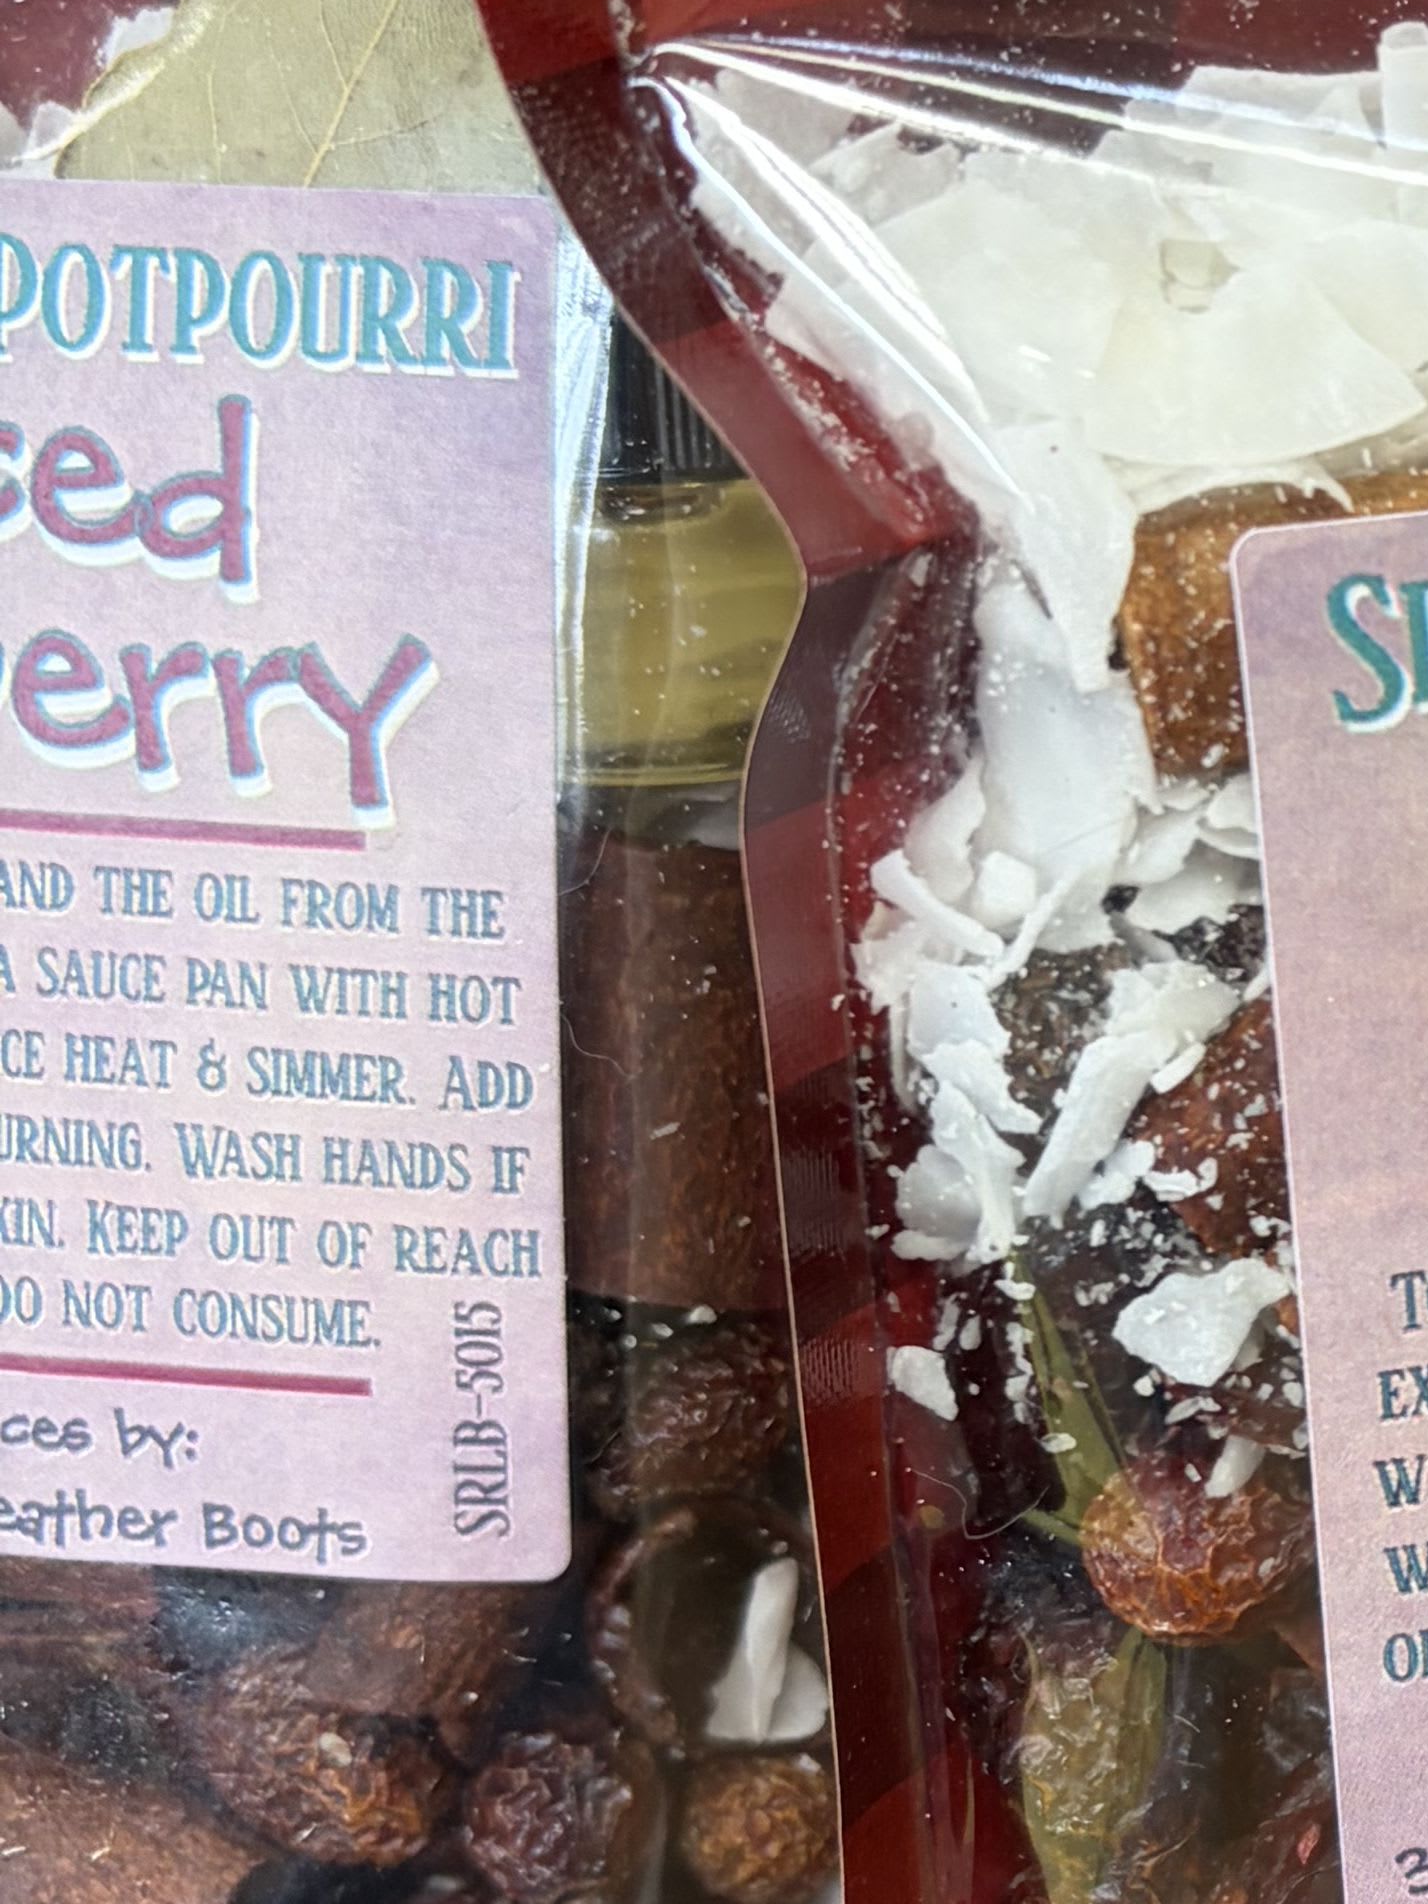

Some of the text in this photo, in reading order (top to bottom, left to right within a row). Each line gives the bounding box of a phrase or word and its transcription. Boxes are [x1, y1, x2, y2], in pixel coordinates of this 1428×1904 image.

[0, 627, 440, 829] erry
[94, 867, 173, 917] THE
[194, 874, 259, 923] OIL
[281, 880, 398, 932] FROM
[421, 888, 504, 938] THE
[37, 948, 166, 1002] SAUCE
[185, 958, 267, 1009] PAN
[288, 965, 407, 1018] WITH
[428, 974, 520, 1024] HOT
[64, 1034, 177, 1088] HEAT
[197, 1039, 226, 1091] &
[247, 1048, 415, 1104] SIMMER.
[437, 1057, 531, 1110] ADD
[174, 1124, 301, 1180] WASH
[322, 1138, 470, 1192] HANDS
[488, 1147, 529, 1193] IF
[87, 1201, 188, 1255] KEEP
[210, 1215, 294, 1264] OUT
[318, 1222, 371, 1269] OF
[393, 1226, 537, 1276] REACH
[63, 1281, 151, 1331] NOT
[174, 1289, 380, 1347] CONSUME.
[114, 1409, 198, 1469] by:
[453, 1300, 510, 1538] SRLB-5015
[202, 1504, 365, 1560] Boots
